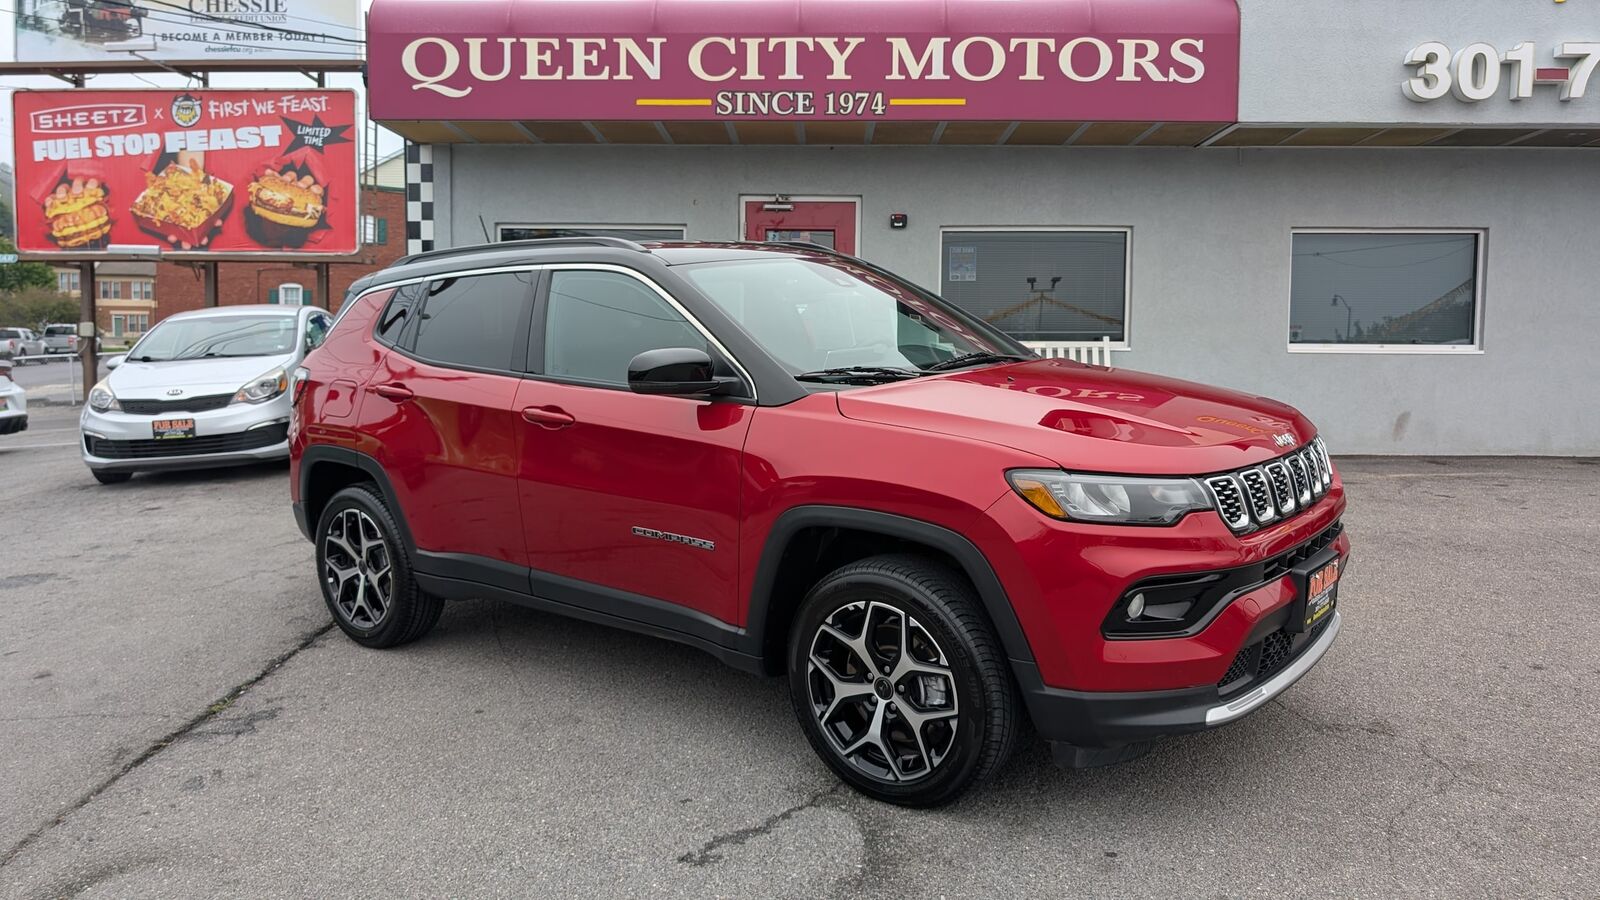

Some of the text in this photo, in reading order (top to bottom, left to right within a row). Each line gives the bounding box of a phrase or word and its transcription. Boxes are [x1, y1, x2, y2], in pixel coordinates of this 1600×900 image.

[189, 0, 287, 13] CHESSIE
[161, 32, 317, 42] BECOME A MEMBER TODAY
[402, 36, 1205, 98] QUEEN CITY MOTORS
[38, 108, 138, 129] SHEETZ
[208, 100, 250, 120] FIRST
[252, 98, 276, 116] WE
[277, 95, 332, 115] FEAST
[716, 91, 886, 116] SINCE 1974
[297, 125, 332, 138] LIMITED
[33, 125, 283, 162] FUEL STOP FEAST
[303, 136, 325, 147] TIME
[1272, 432, 1296, 447] Jeep
[632, 526, 715, 550] COMPASS
